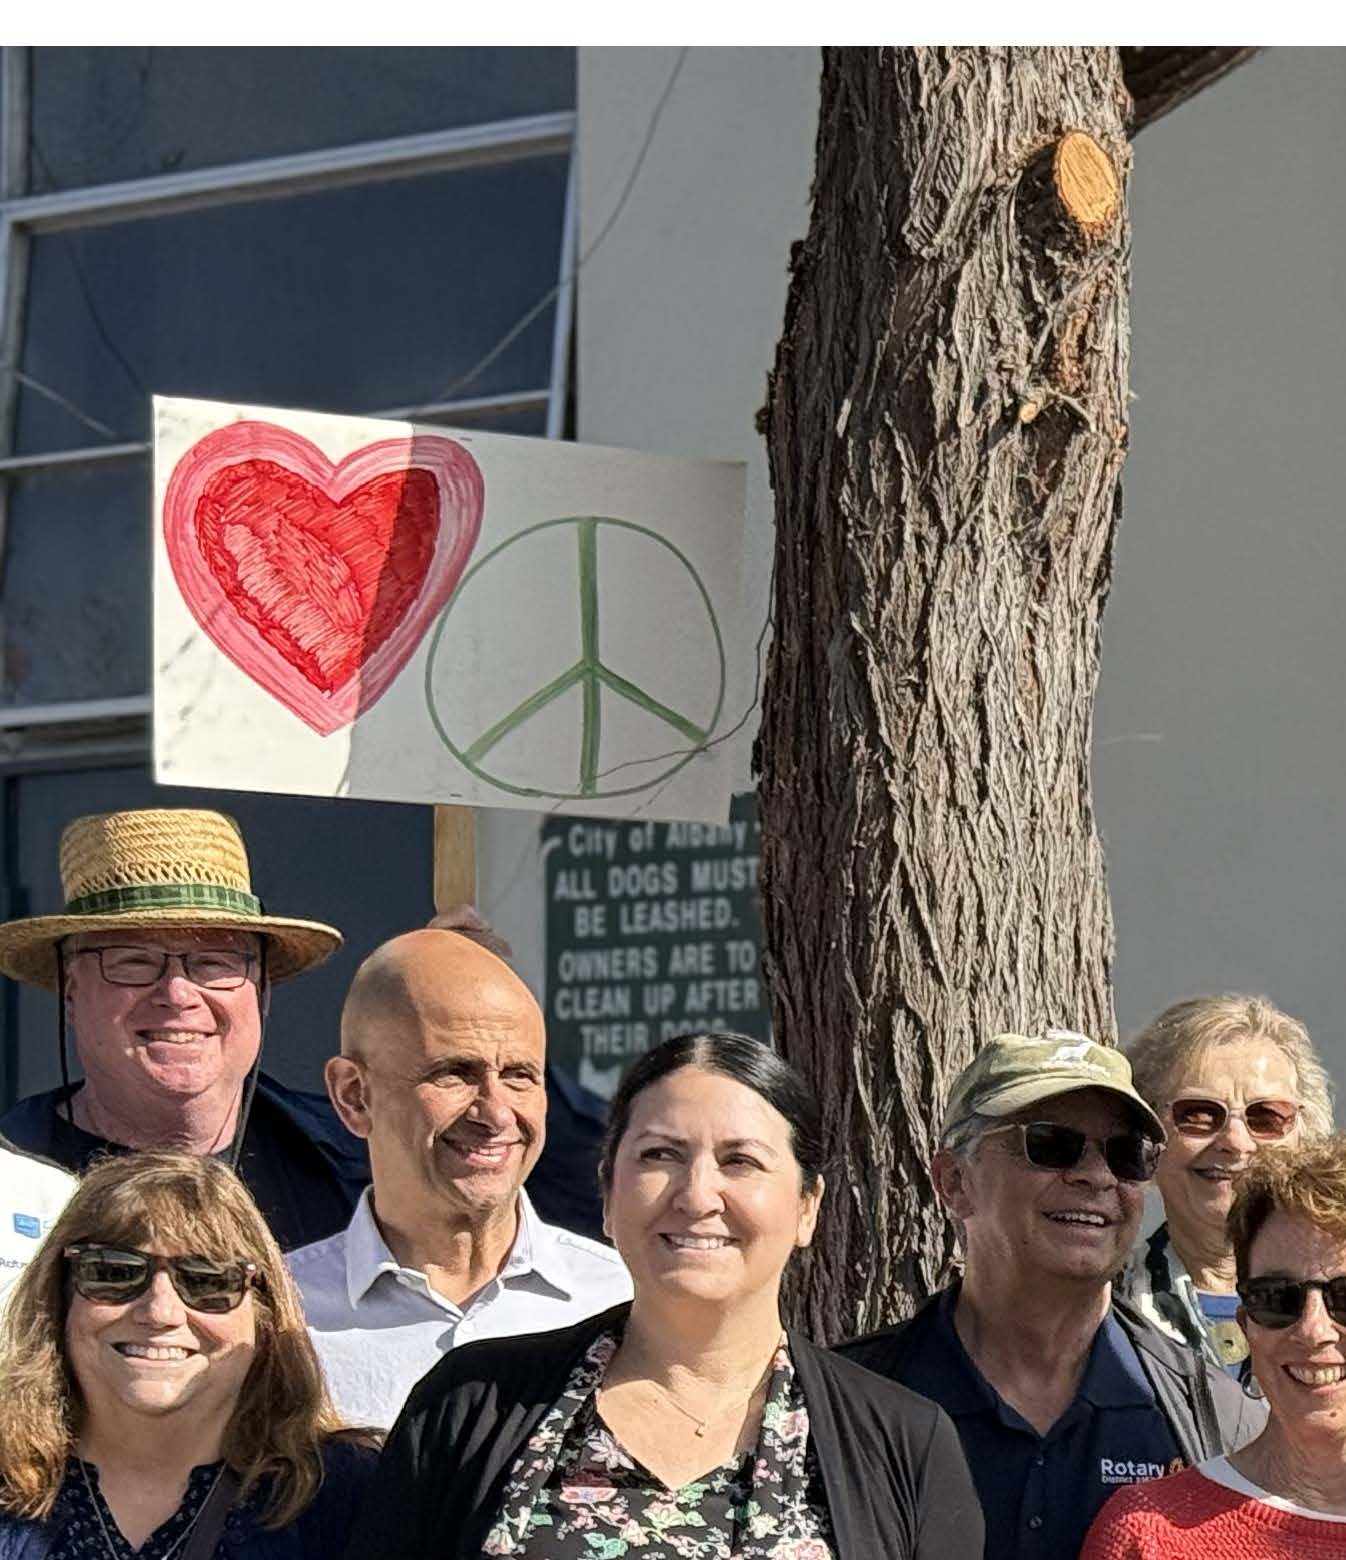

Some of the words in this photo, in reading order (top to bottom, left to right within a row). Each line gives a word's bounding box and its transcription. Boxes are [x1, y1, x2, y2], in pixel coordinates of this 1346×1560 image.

[569, 825, 617, 860] City
[629, 822, 654, 853] of
[554, 868, 597, 900] ALL
[608, 861, 678, 898] DOGS
[691, 857, 761, 892] MUST
[574, 905, 606, 937] BE
[620, 898, 740, 934] LEASHED.
[558, 947, 658, 982] OWNERS
[669, 944, 715, 976] ARE
[725, 940, 756, 972] TO
[554, 987, 630, 1020] CLEAN
[643, 983, 675, 1015] UP
[685, 980, 760, 1011] AFTER
[580, 1020, 648, 1055] THEIR
[1101, 1458, 1165, 1479] Rotary
